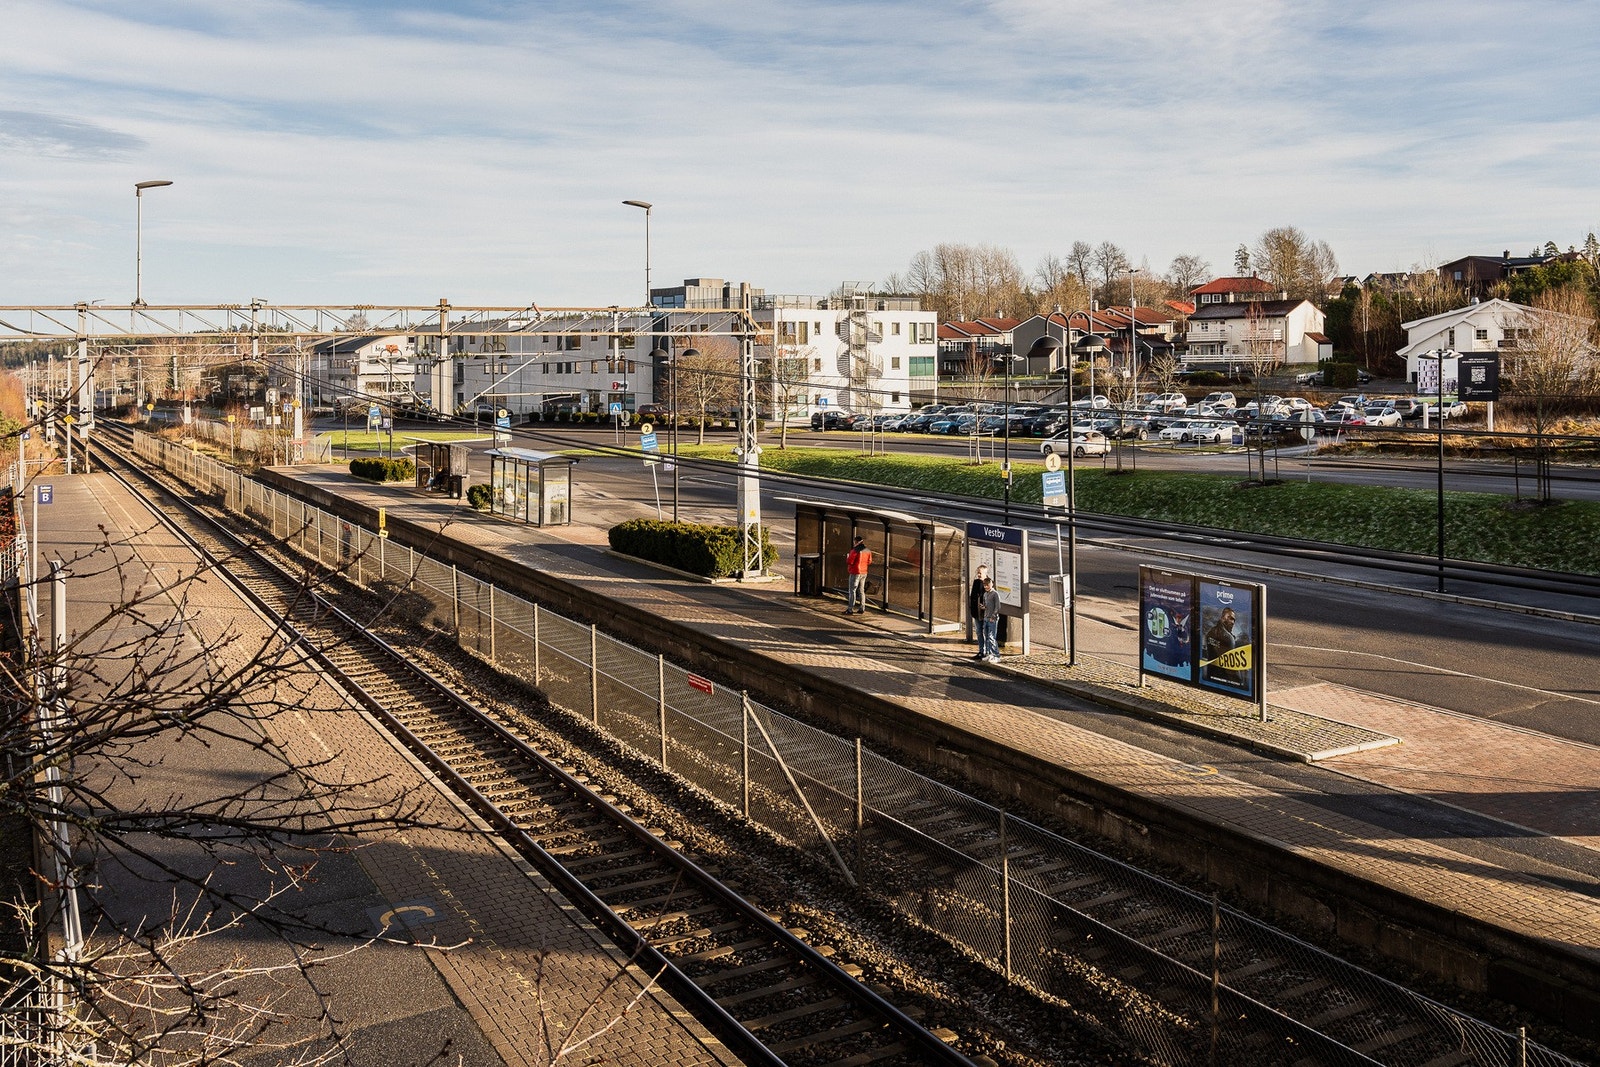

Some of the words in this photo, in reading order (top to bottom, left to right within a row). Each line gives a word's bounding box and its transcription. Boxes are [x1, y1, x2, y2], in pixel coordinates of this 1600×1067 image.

[1050, 456, 1056, 468] 1
[42, 493, 50, 502] B
[984, 526, 1006, 540] Vestby
[1216, 590, 1234, 600] prime
[1218, 650, 1247, 668] CROSS
